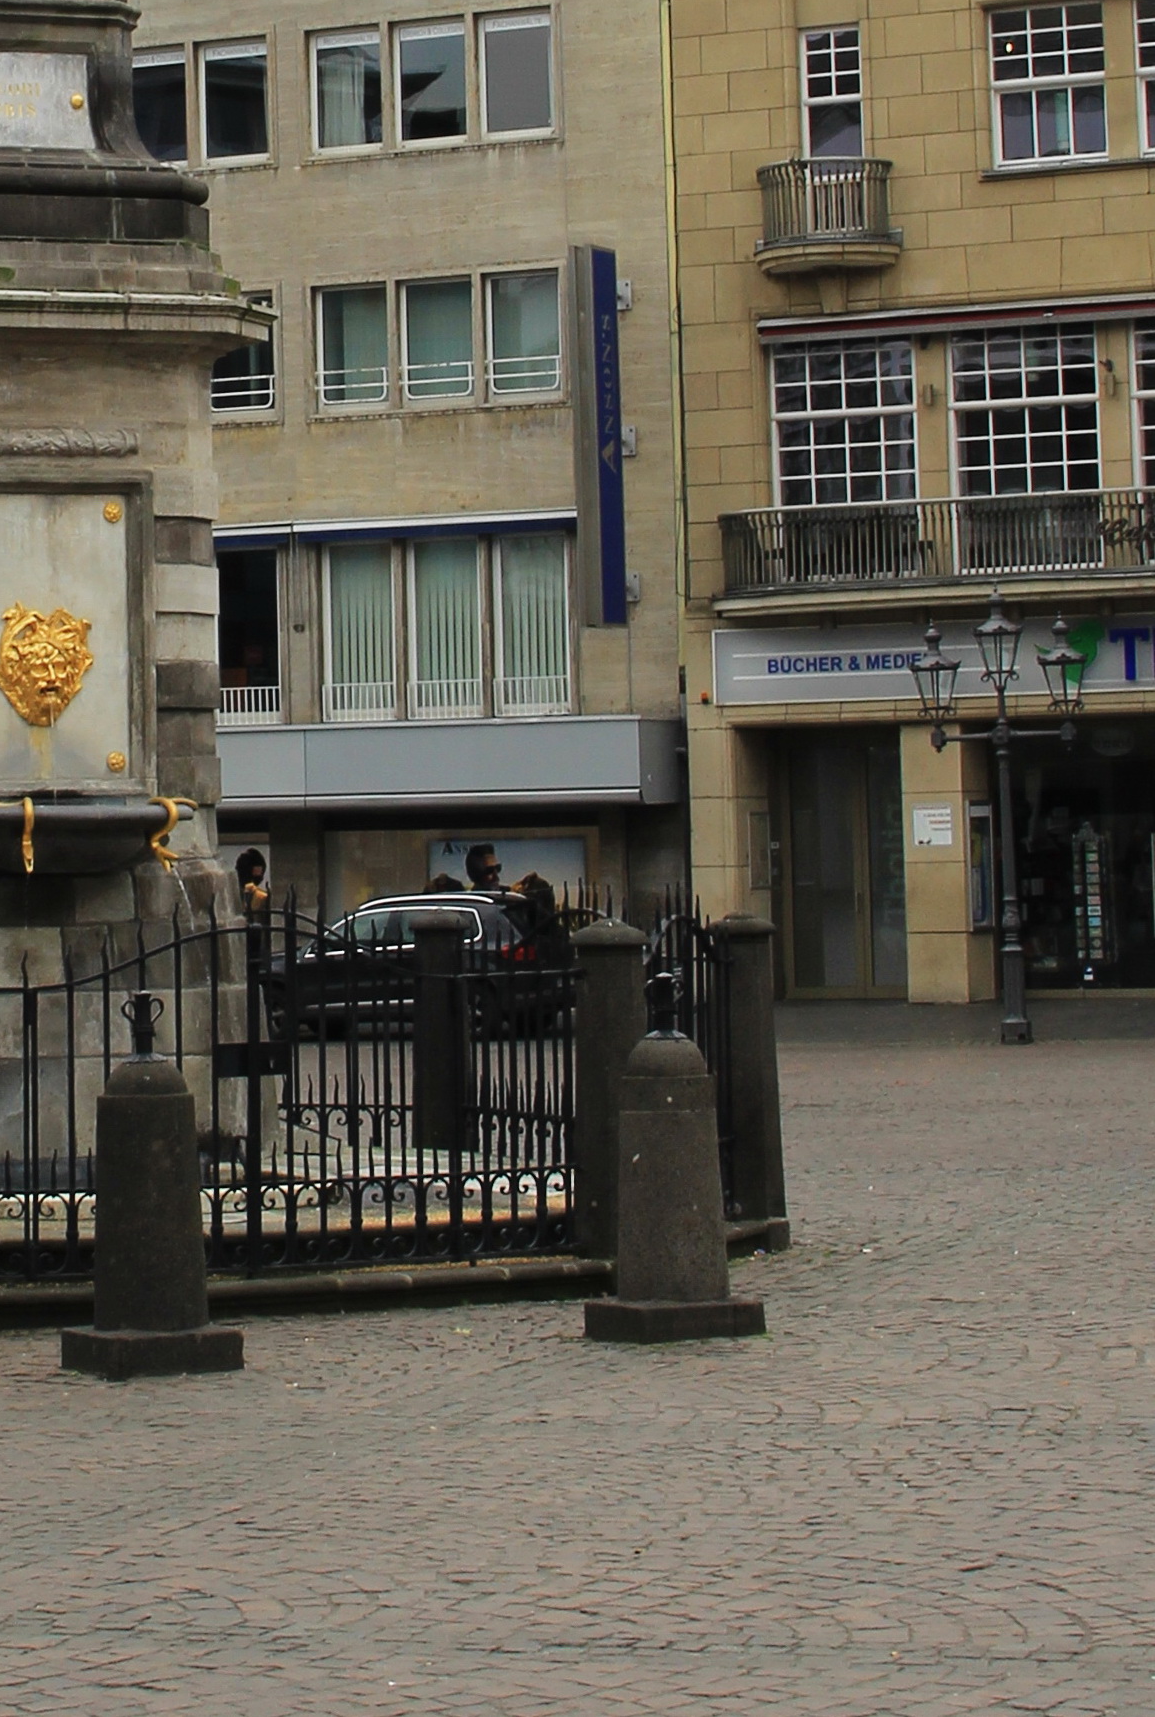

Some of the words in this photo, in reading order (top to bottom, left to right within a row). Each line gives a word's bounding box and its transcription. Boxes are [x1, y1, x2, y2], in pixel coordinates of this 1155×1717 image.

[767, 656, 843, 674] BÜCHER
[848, 657, 860, 671] &
[866, 652, 928, 670] MEDIE
